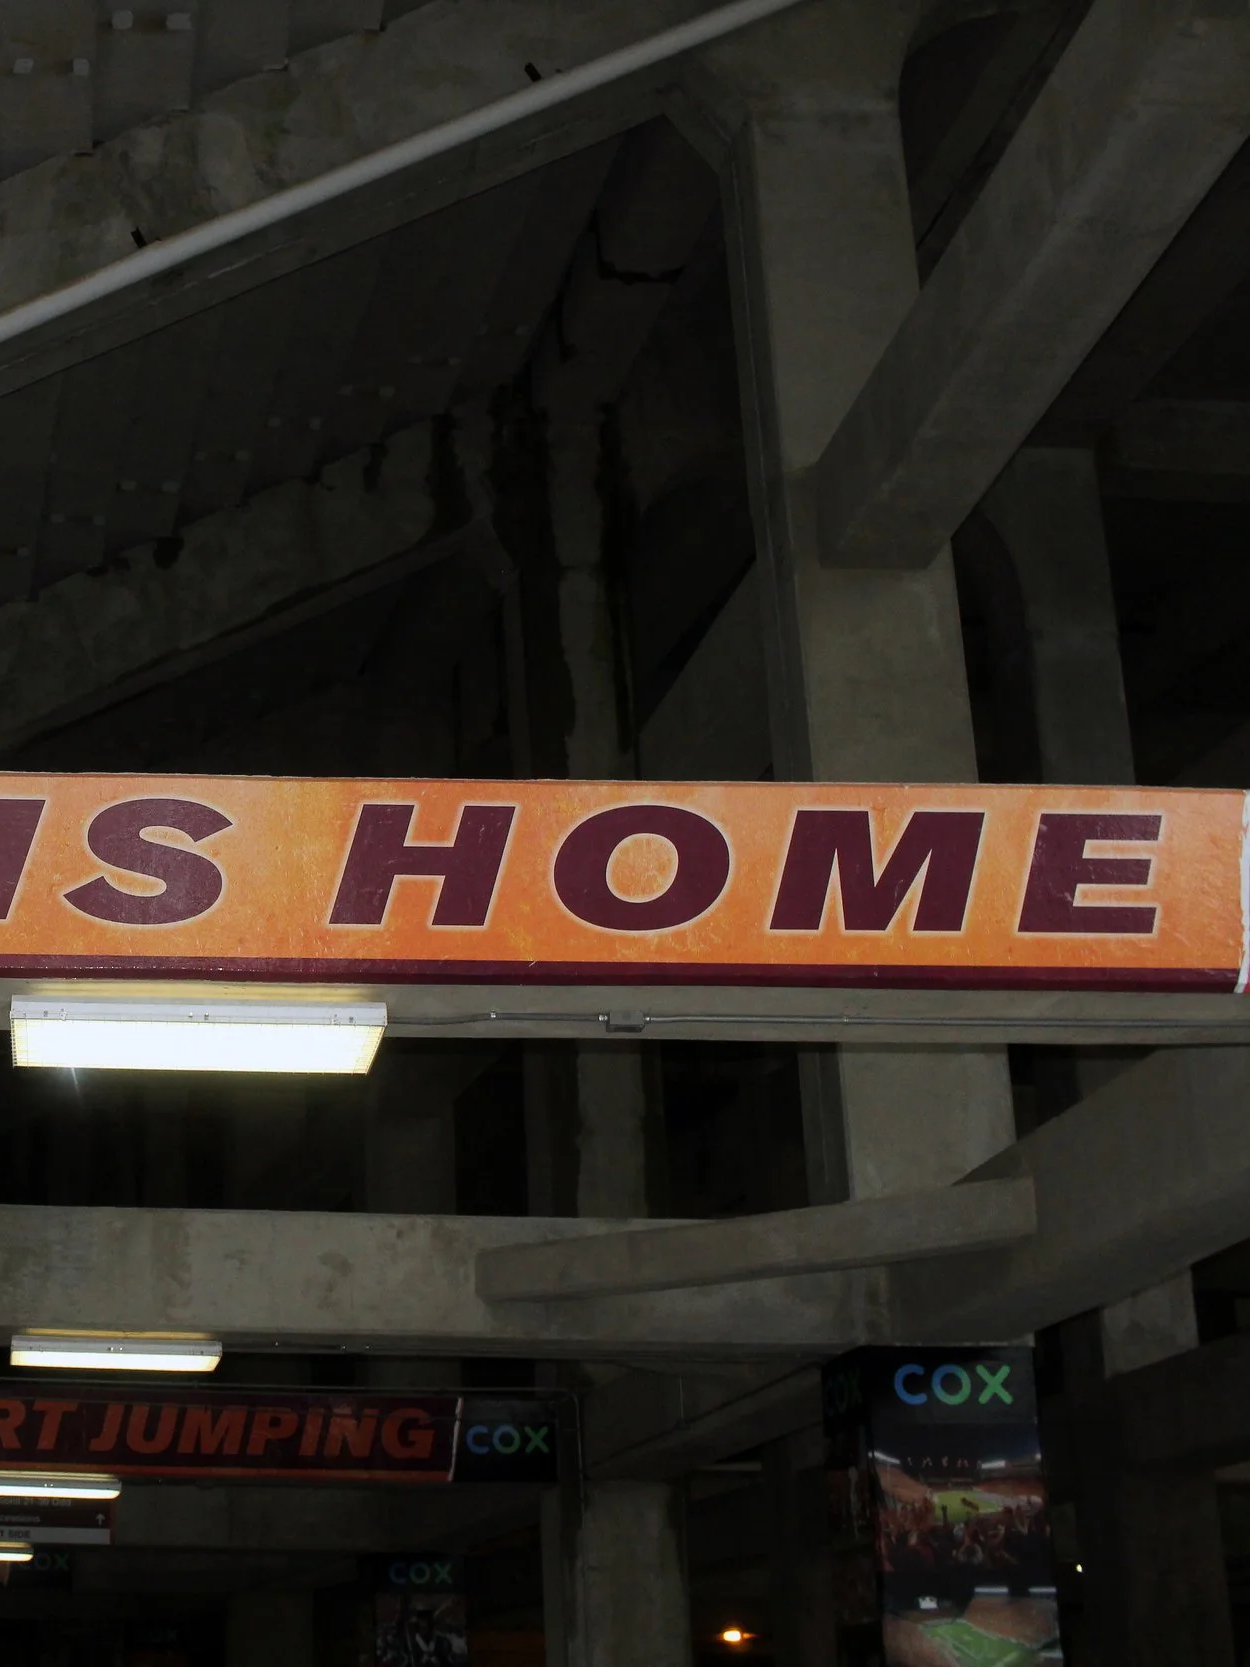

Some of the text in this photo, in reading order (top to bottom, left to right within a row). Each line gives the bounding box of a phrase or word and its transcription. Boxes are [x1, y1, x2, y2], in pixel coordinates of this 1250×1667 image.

[328, 801, 1163, 935] HOME
[893, 1362, 1015, 1406] COX
[89, 1402, 436, 1459] JUMPING
[466, 1422, 550, 1455] COX
[8, 1530, 31, 1539] SIDE
[388, 1560, 453, 1585] COX
